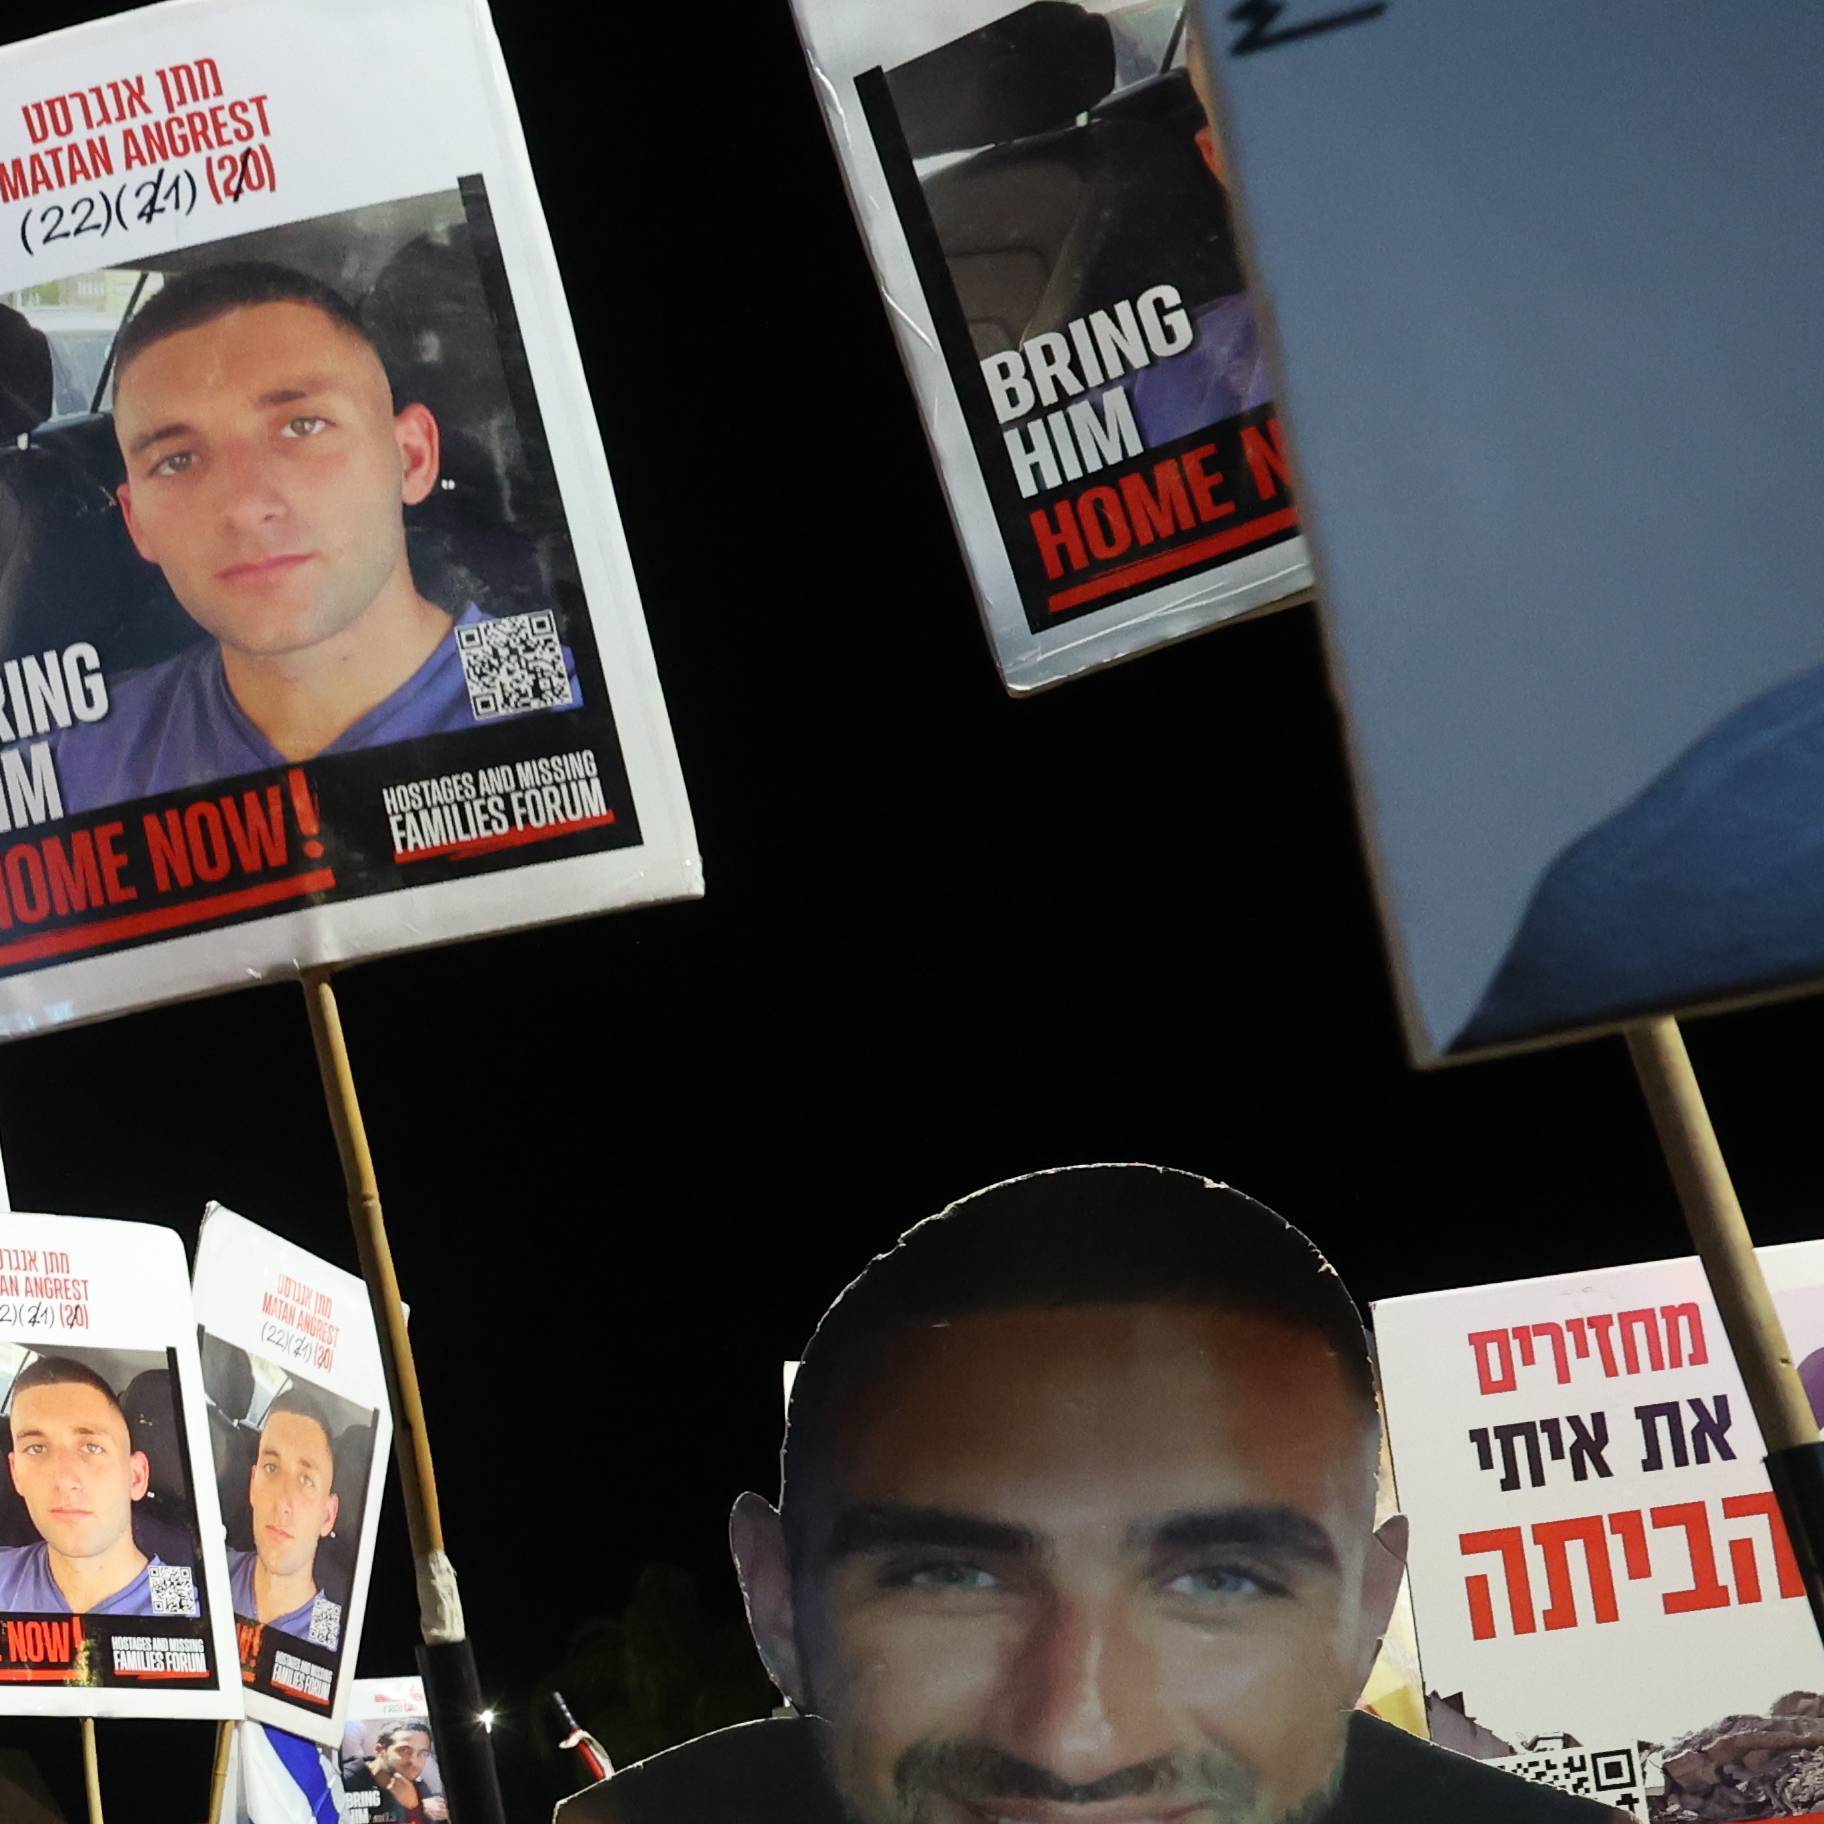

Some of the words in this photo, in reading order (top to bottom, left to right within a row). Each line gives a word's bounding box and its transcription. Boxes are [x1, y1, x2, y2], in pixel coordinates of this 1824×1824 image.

[22, 75, 152, 144] אנגרסט
[155, 58, 223, 113] מתן
[122, 94, 271, 171] ANGREST
[980, 284, 1194, 425] BRING
[1003, 385, 1144, 499] HIM
[1030, 443, 1236, 580] HOME
[382, 772, 476, 815] HOSTAGES
[478, 765, 516, 796] AND
[516, 749, 597, 789] MISSING
[389, 796, 510, 854] FAMILIES
[511, 778, 607, 831] FORUM
[149, 768, 325, 890] NOW!
[23, 1277, 89, 1302] ANGREST
[262, 1291, 296, 1327] MATAN
[1468, 1301, 1708, 1396] מחזירים
[1469, 1411, 1614, 1492] איתי
[1634, 1394, 1738, 1472] את
[1459, 1490, 1806, 1642] הביתה
[112, 1636, 152, 1651] HOSTAGES
[152, 1638, 169, 1651] AND
[169, 1638, 204, 1652] MISSING
[113, 1651, 164, 1672] FAMILIES
[166, 1652, 207, 1672] FORUM
